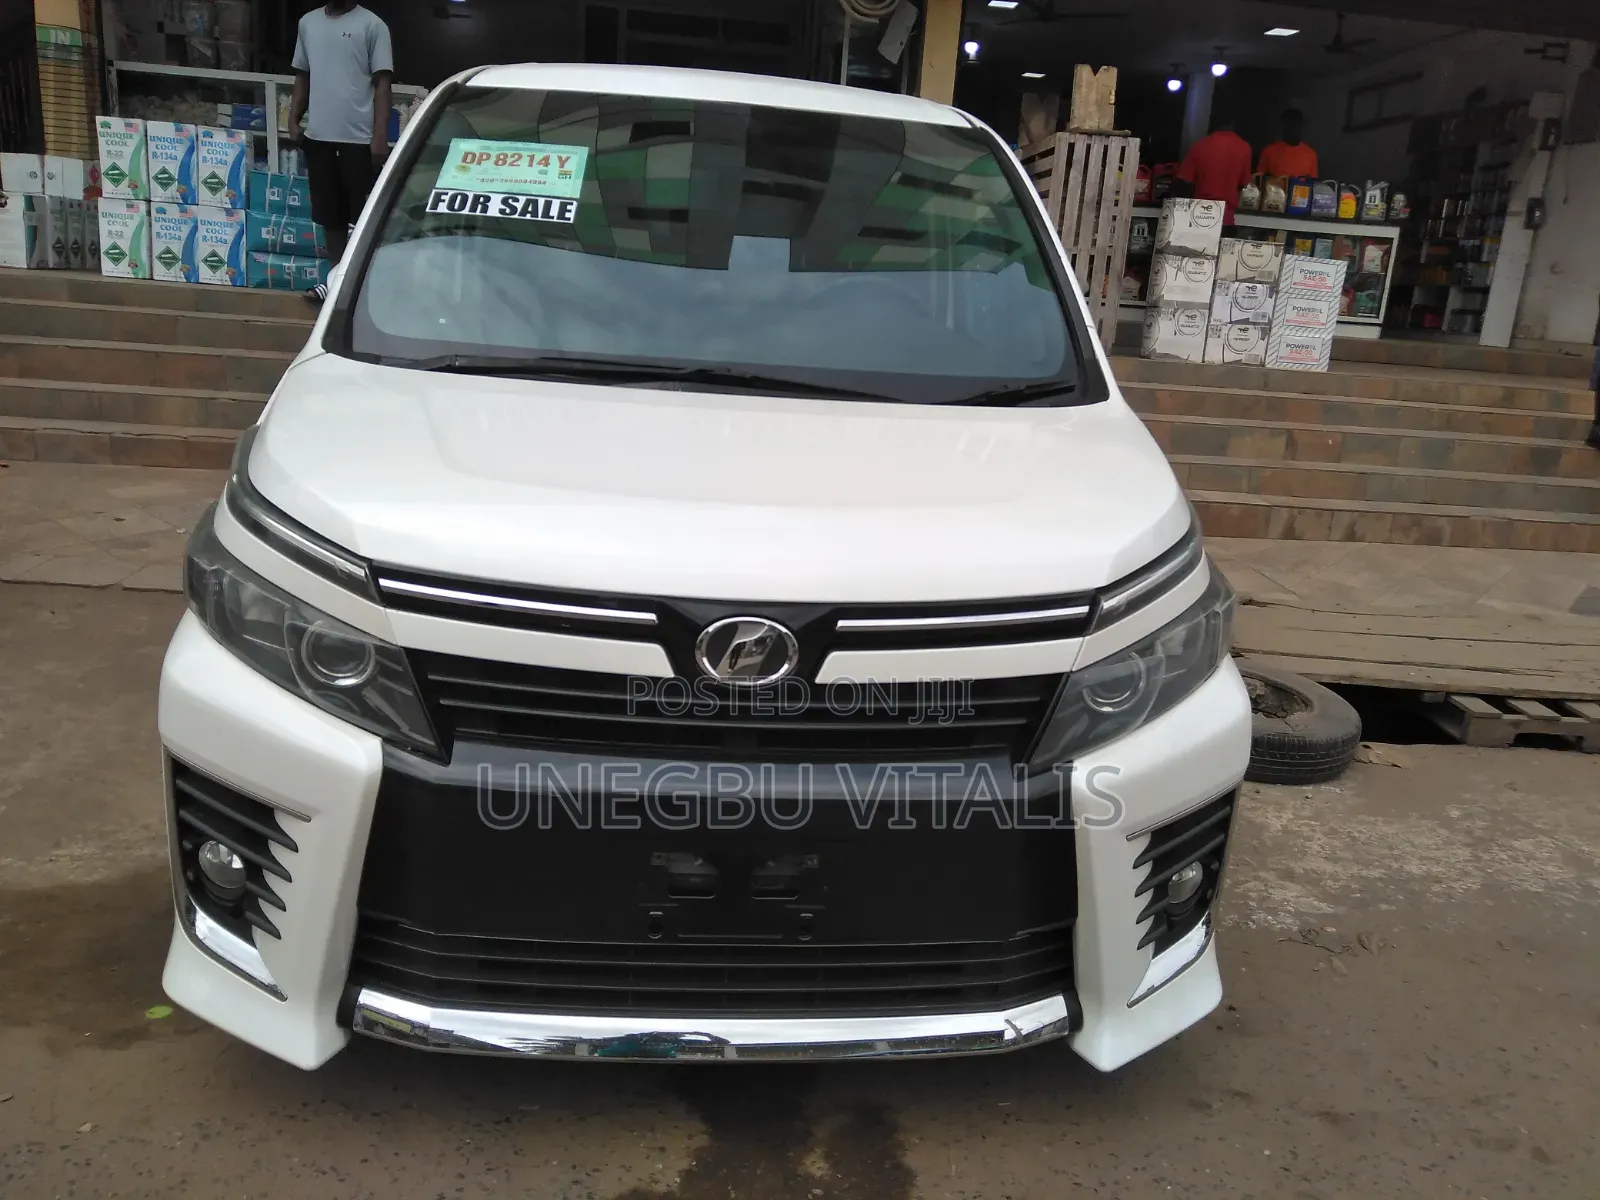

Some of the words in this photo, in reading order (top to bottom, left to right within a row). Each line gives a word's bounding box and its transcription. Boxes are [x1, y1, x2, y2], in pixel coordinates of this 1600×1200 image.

[105, 139, 129, 147] COOL
[155, 143, 178, 151] COOL
[152, 151, 178, 161] R-134a
[206, 148, 229, 157] COOL
[202, 155, 228, 166] R-134a
[461, 151, 491, 166] DP
[557, 155, 571, 168] Y
[428, 191, 492, 214] FOR
[498, 195, 575, 222] SALE
[101, 211, 134, 220] UNIQUE
[154, 216, 188, 225] UNIQUE
[200, 219, 234, 229] UNIQUE
[160, 224, 183, 232] COOL
[205, 227, 229, 236] COOL
[107, 229, 124, 237] R-22
[155, 231, 182, 241] R-134a
[202, 235, 228, 245] R-134a
